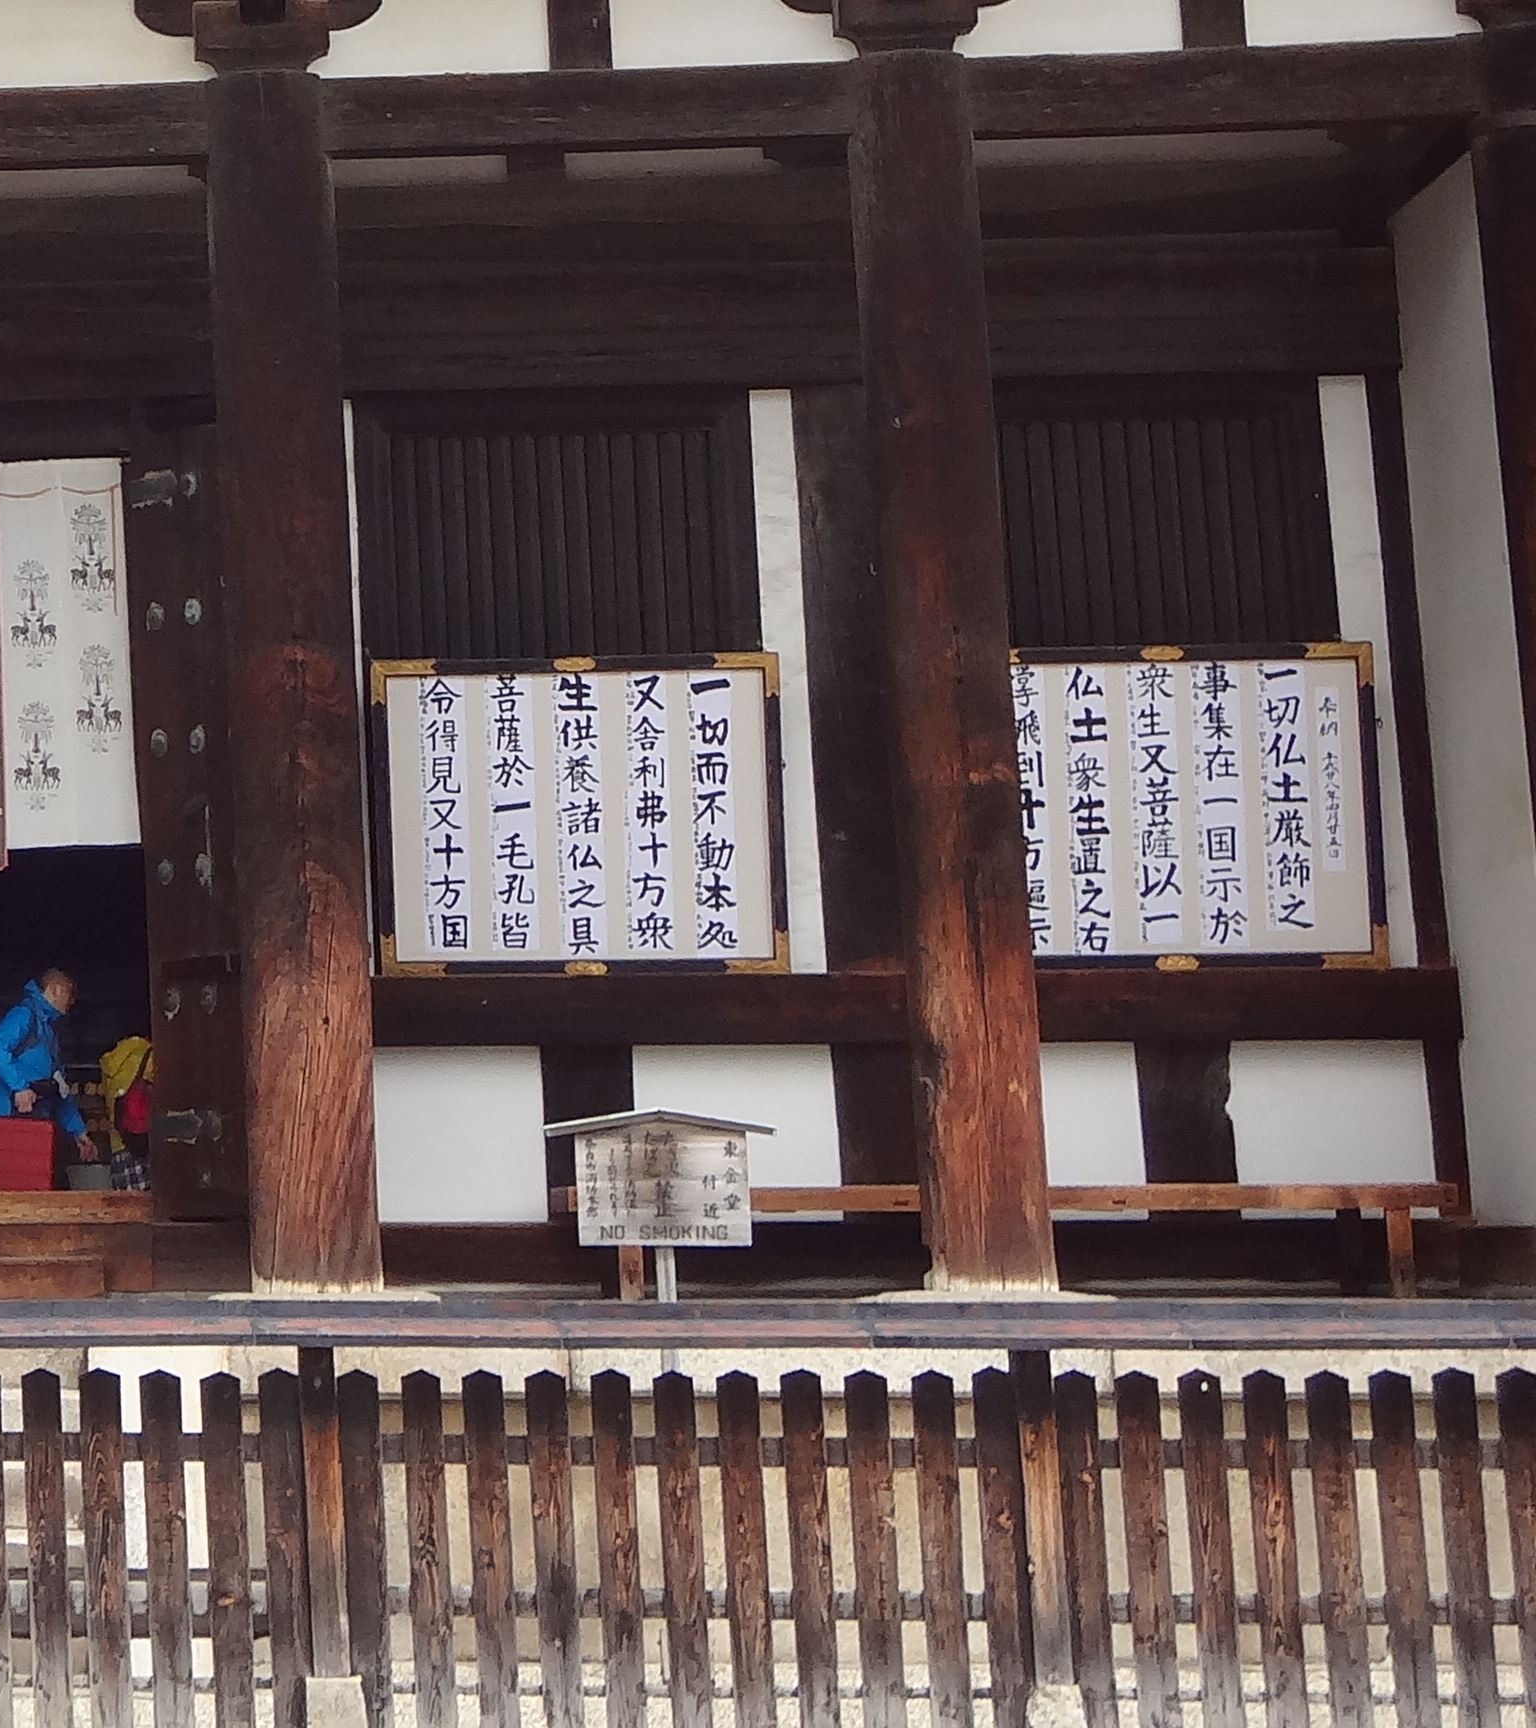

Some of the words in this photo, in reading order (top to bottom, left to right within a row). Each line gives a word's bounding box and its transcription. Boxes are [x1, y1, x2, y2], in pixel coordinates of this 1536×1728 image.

[424, 677, 468, 950] 令得見又十方国
[489, 674, 534, 949] 菩薩於一毛孔皆
[557, 673, 606, 955] 生供養諸仏之具
[1066, 666, 1112, 953] 仏土衆生置之右
[1135, 663, 1183, 925] 衆生又菩薩以一
[1198, 662, 1248, 944] 事集在一国示於
[600, 1225, 625, 1240] NO
[639, 1224, 729, 1241] SMOKING
[702, 1175, 721, 1219] 付近
[723, 1140, 741, 1211] 東金堂
